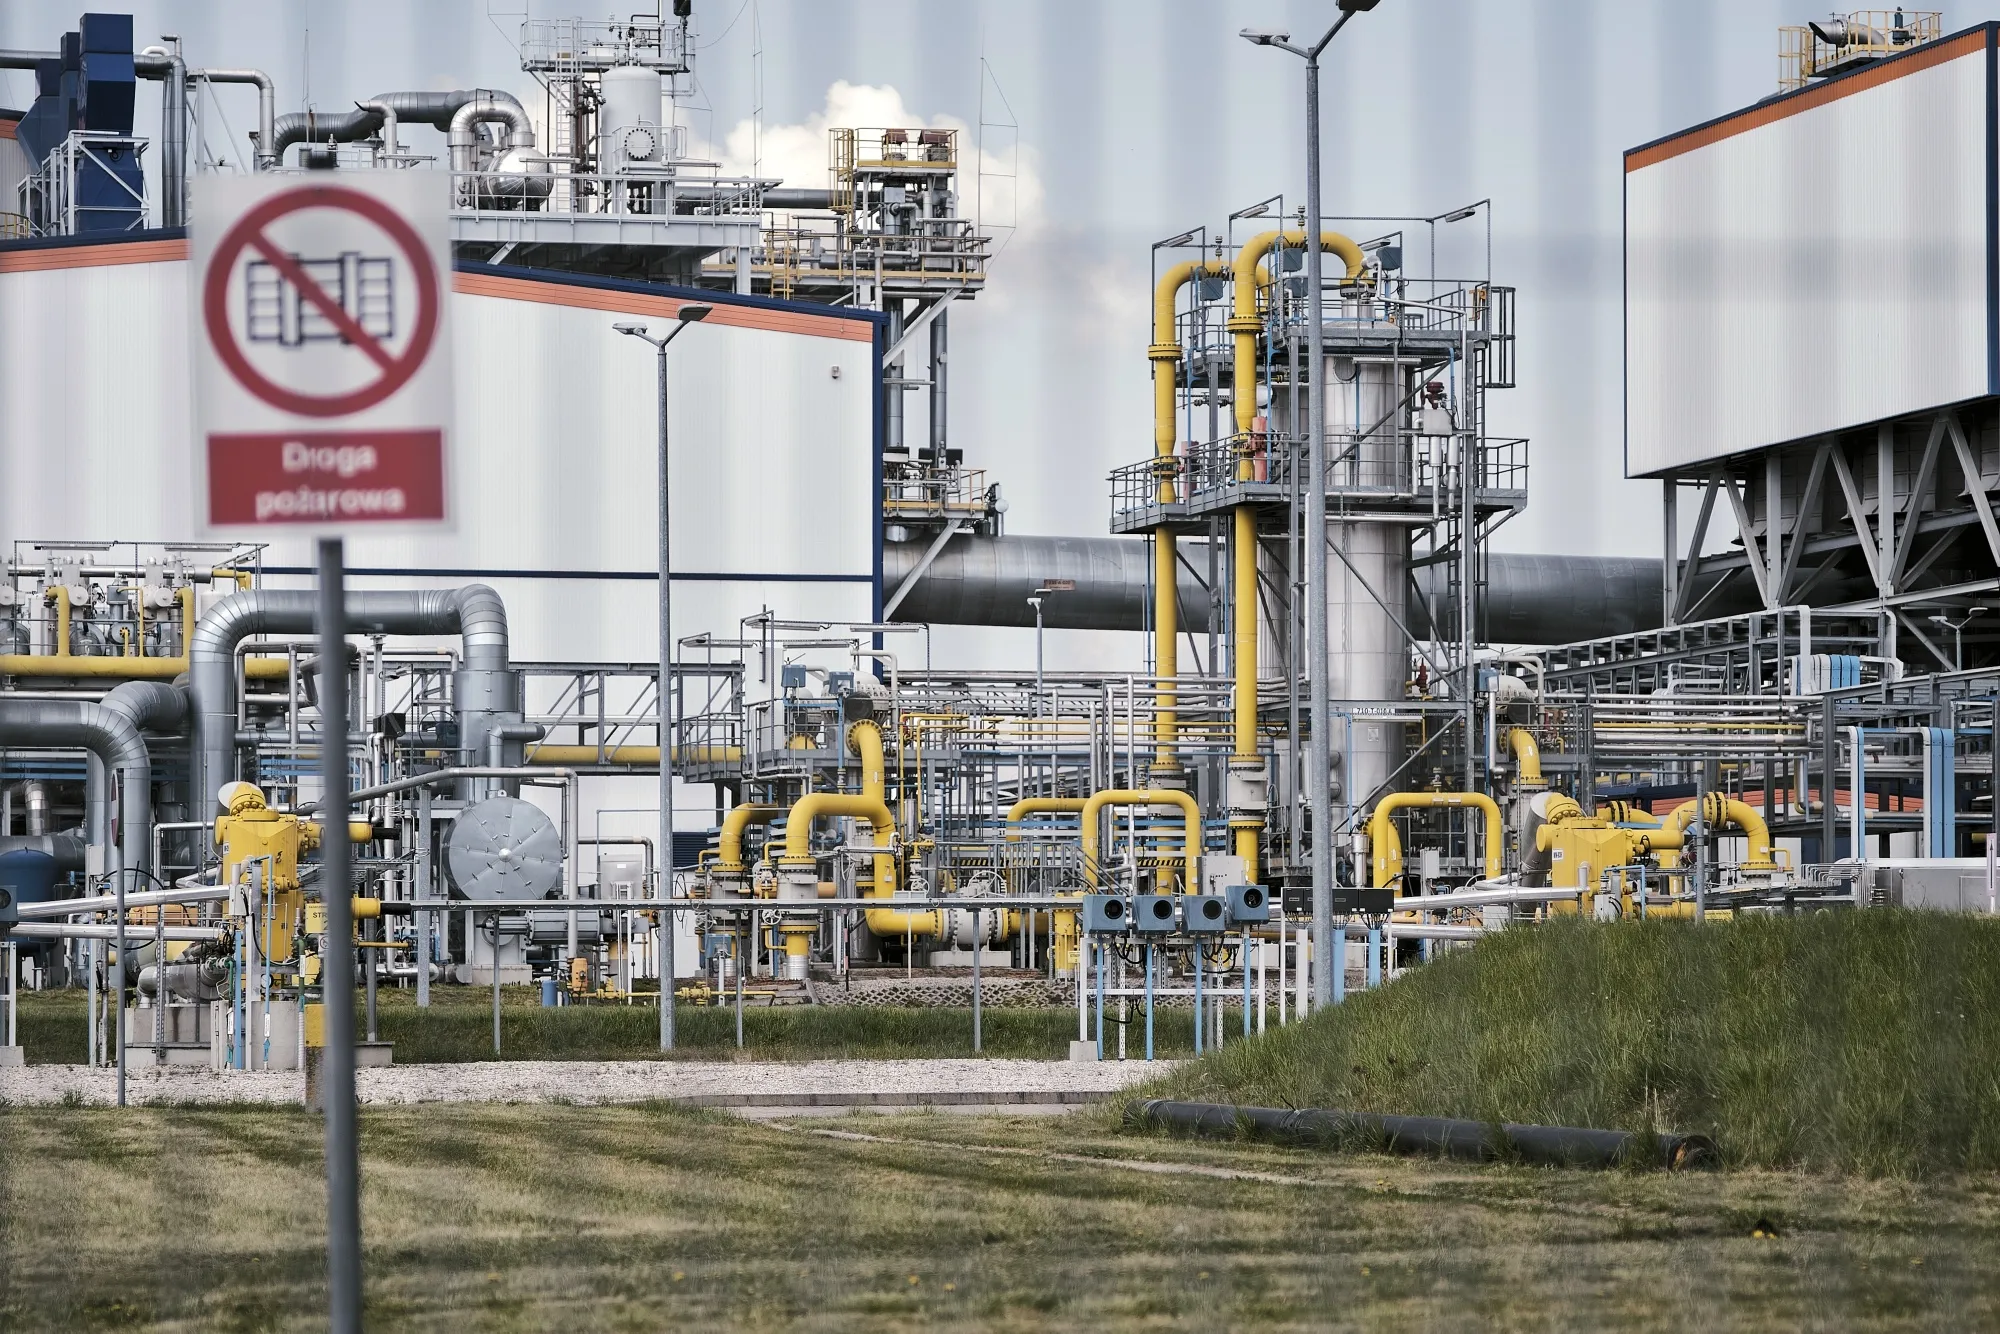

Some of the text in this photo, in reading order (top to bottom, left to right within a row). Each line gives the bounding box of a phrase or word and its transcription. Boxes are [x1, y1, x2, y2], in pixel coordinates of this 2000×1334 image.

[282, 442, 377, 477] Droga
[256, 485, 405, 521] pożarowa
[312, 911, 328, 919] STR
